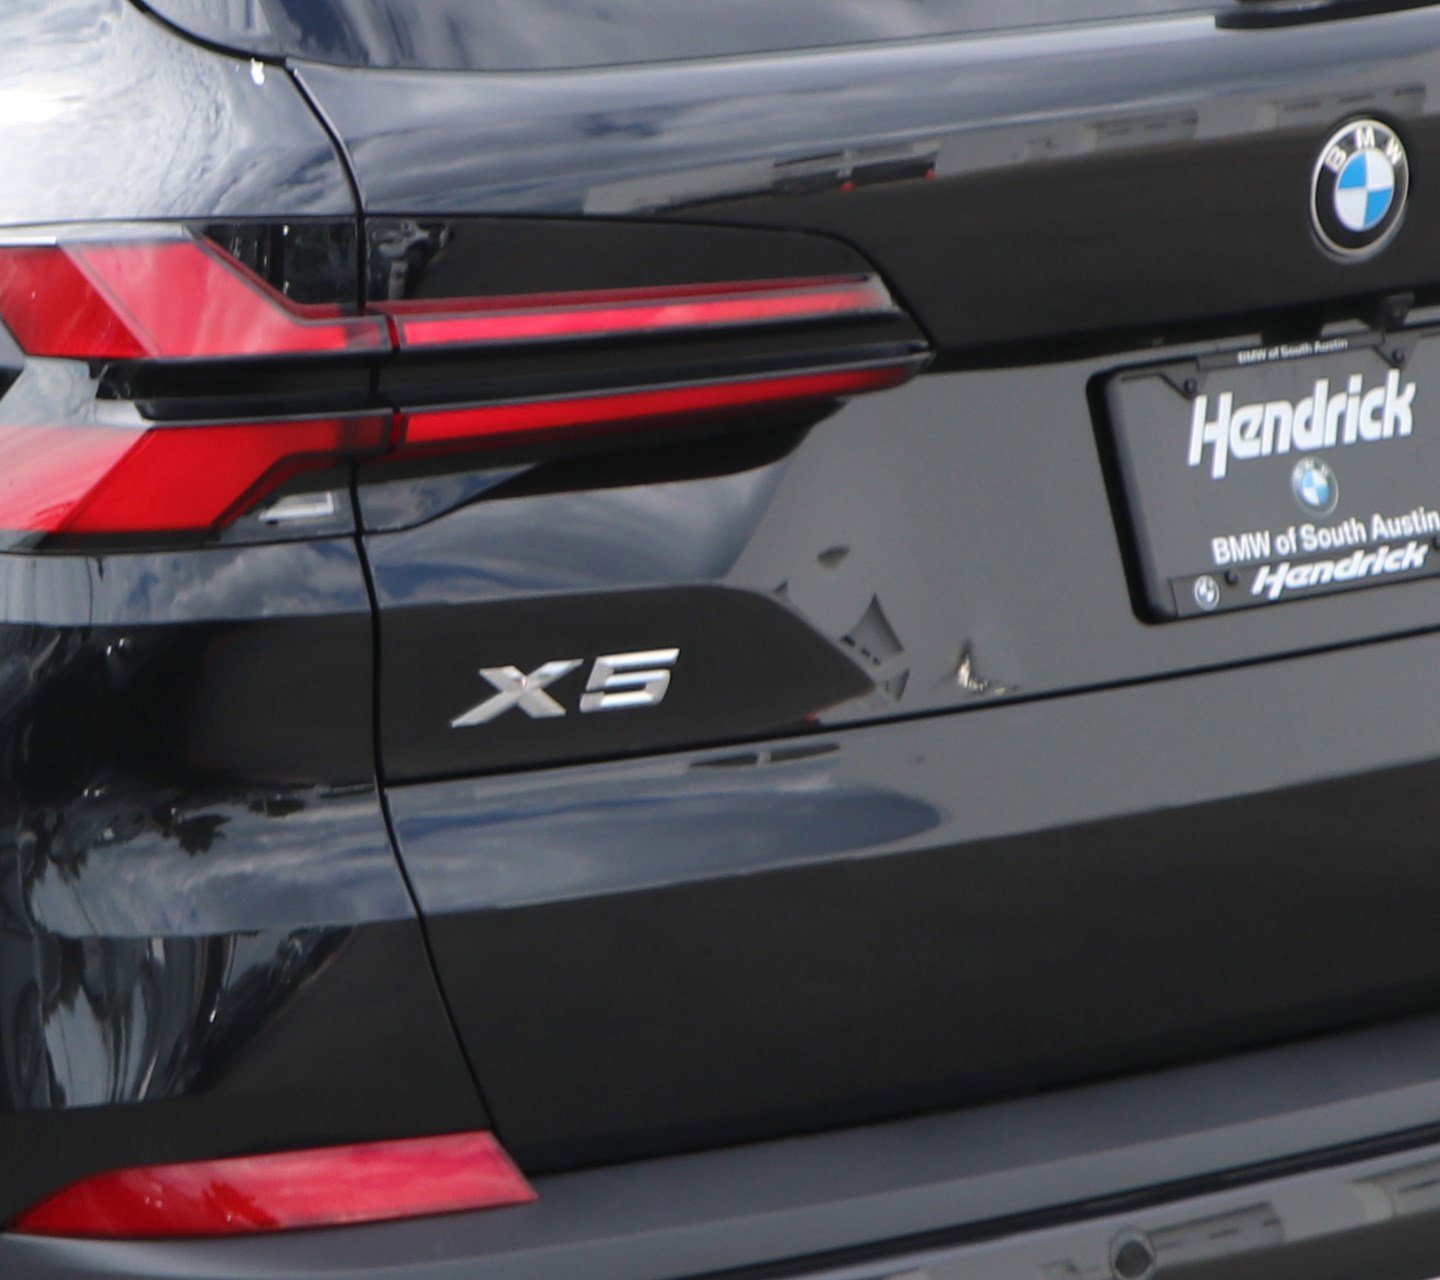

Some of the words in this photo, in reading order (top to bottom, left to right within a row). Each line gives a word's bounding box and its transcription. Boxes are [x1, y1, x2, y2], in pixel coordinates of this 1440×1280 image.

[1325, 125, 1402, 172] BMW
[1237, 347, 1267, 365] BMW
[1267, 345, 1280, 361] of
[1280, 342, 1313, 359] South
[1314, 337, 1348, 354] Austin
[1188, 368, 1417, 480] Hendrick
[1211, 530, 1271, 566] BMW
[1275, 525, 1298, 555] of
[1299, 517, 1368, 553] South
[1250, 540, 1430, 601] Hendrick
[450, 647, 681, 729] X5
